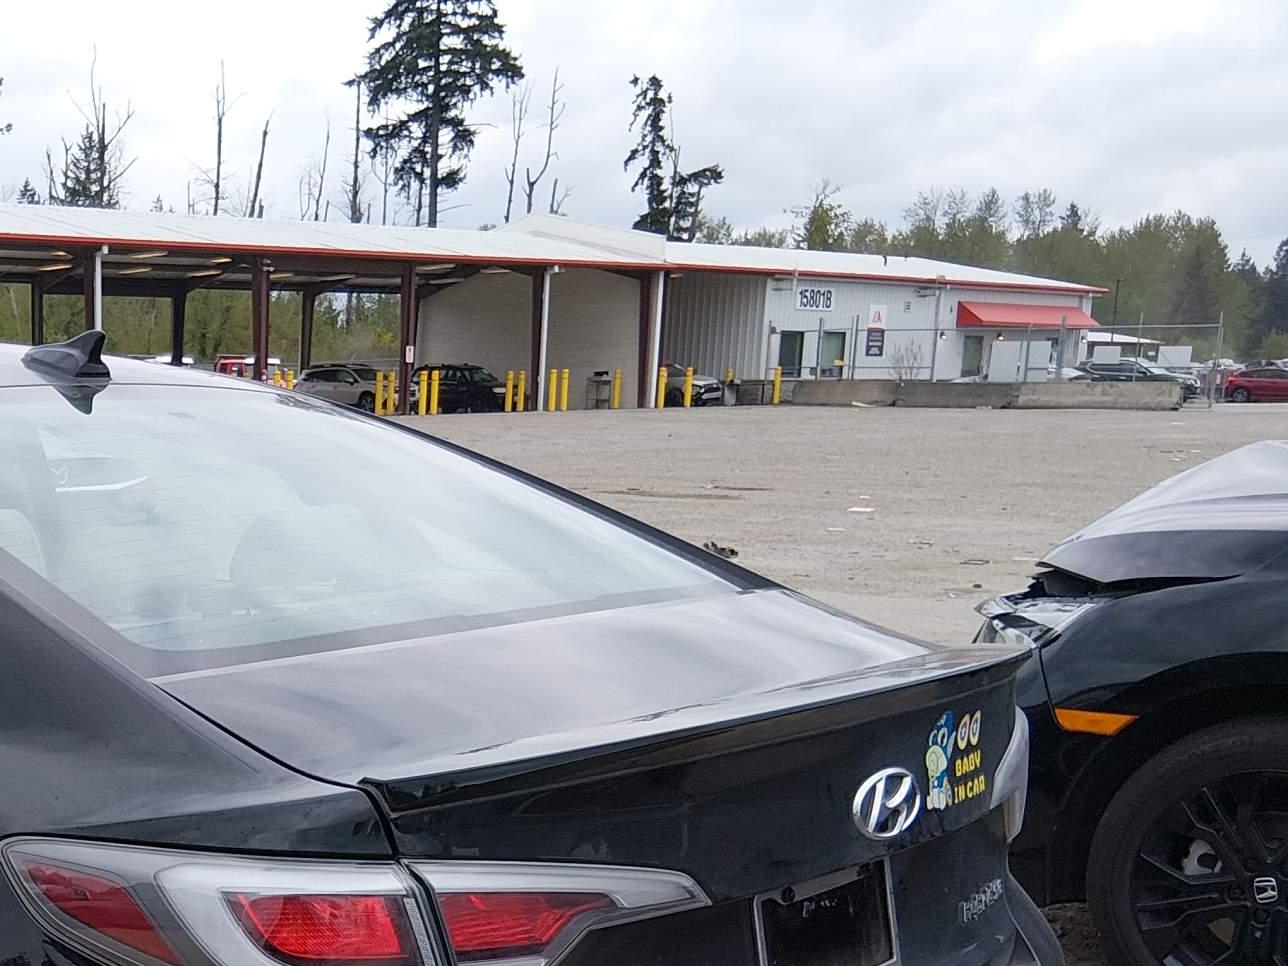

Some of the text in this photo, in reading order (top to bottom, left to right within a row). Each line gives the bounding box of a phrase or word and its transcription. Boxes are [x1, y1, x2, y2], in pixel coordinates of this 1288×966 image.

[799, 288, 833, 309] 15801B
[955, 749, 982, 777] BABY
[953, 774, 986, 804] IN CAR
